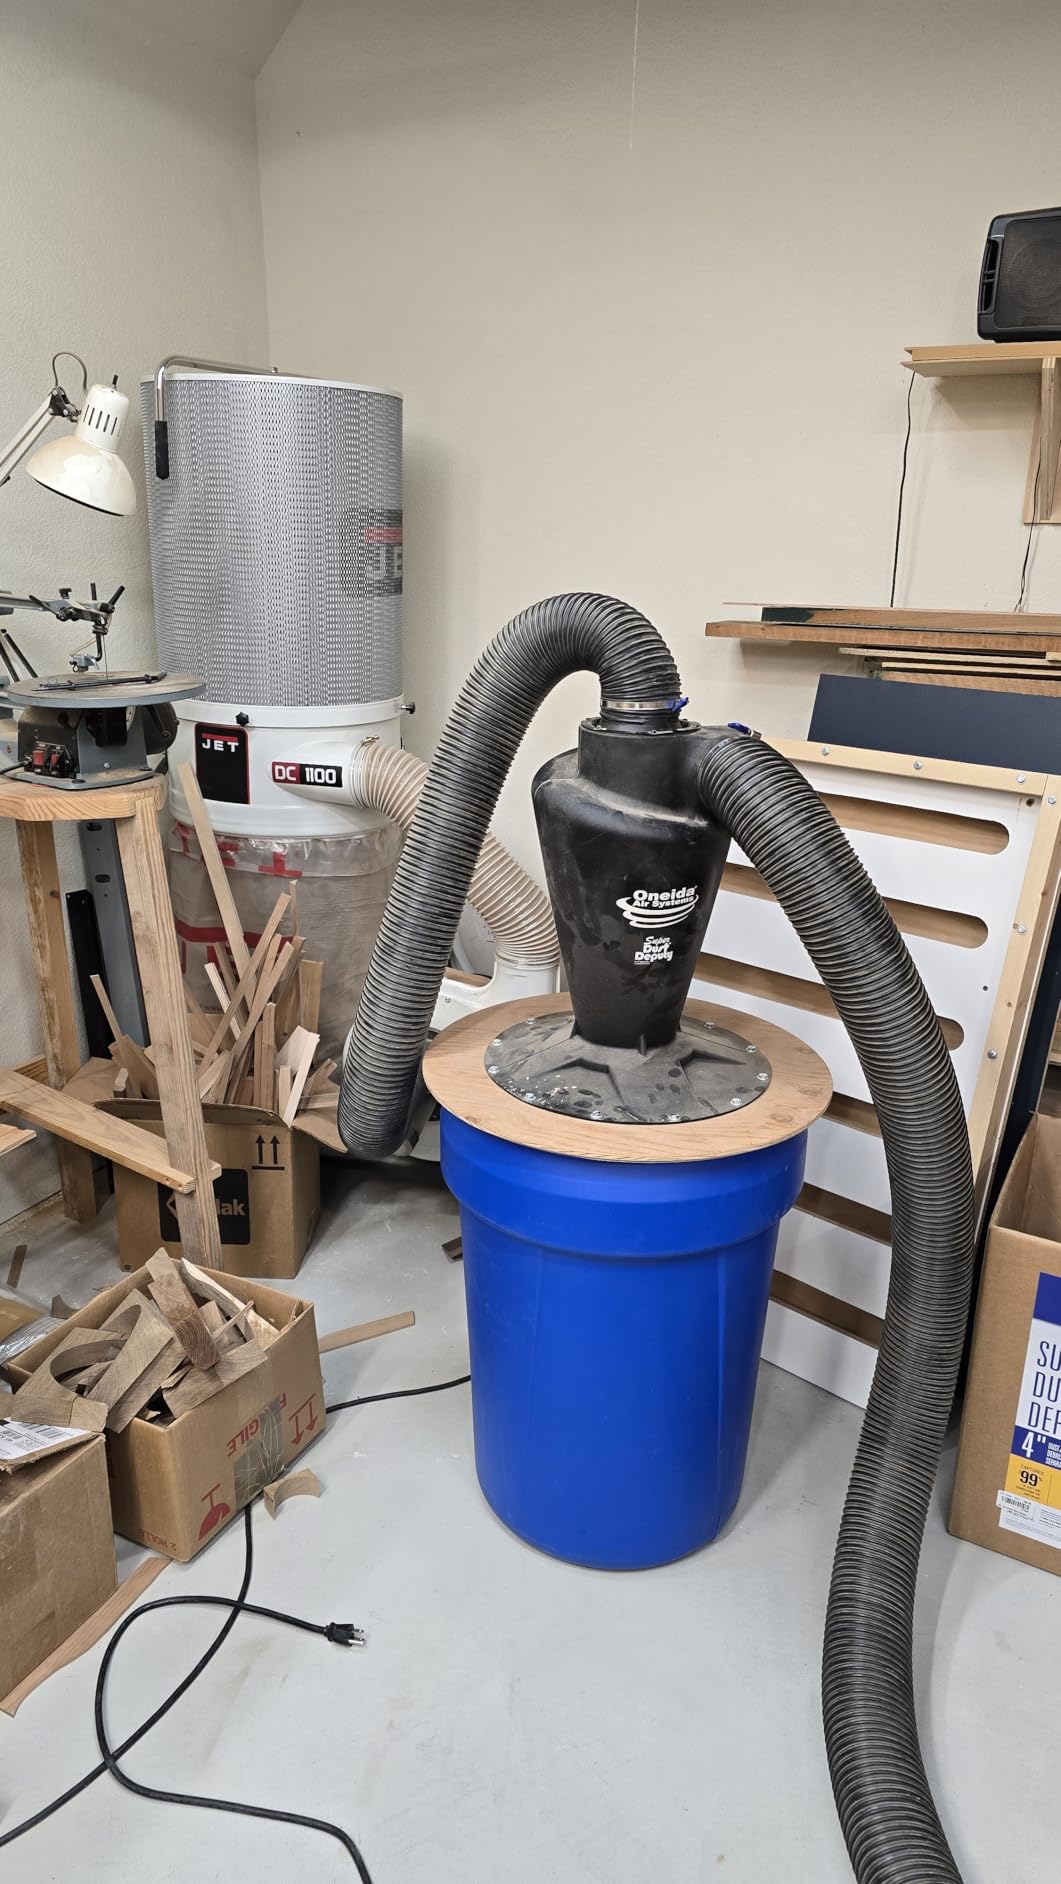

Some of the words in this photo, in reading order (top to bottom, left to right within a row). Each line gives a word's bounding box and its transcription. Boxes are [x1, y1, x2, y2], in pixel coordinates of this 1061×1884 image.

[202, 738, 239, 753] JET
[274, 765, 297, 781] DC
[304, 767, 337, 784] 1100
[632, 887, 695, 902] Oneida
[632, 900, 650, 908] Air
[651, 896, 694, 908] Systems
[645, 936, 671, 945] Super
[643, 942, 671, 954] Dust
[634, 950, 673, 963] Deputy
[226, 1392, 287, 1457] FGILE
